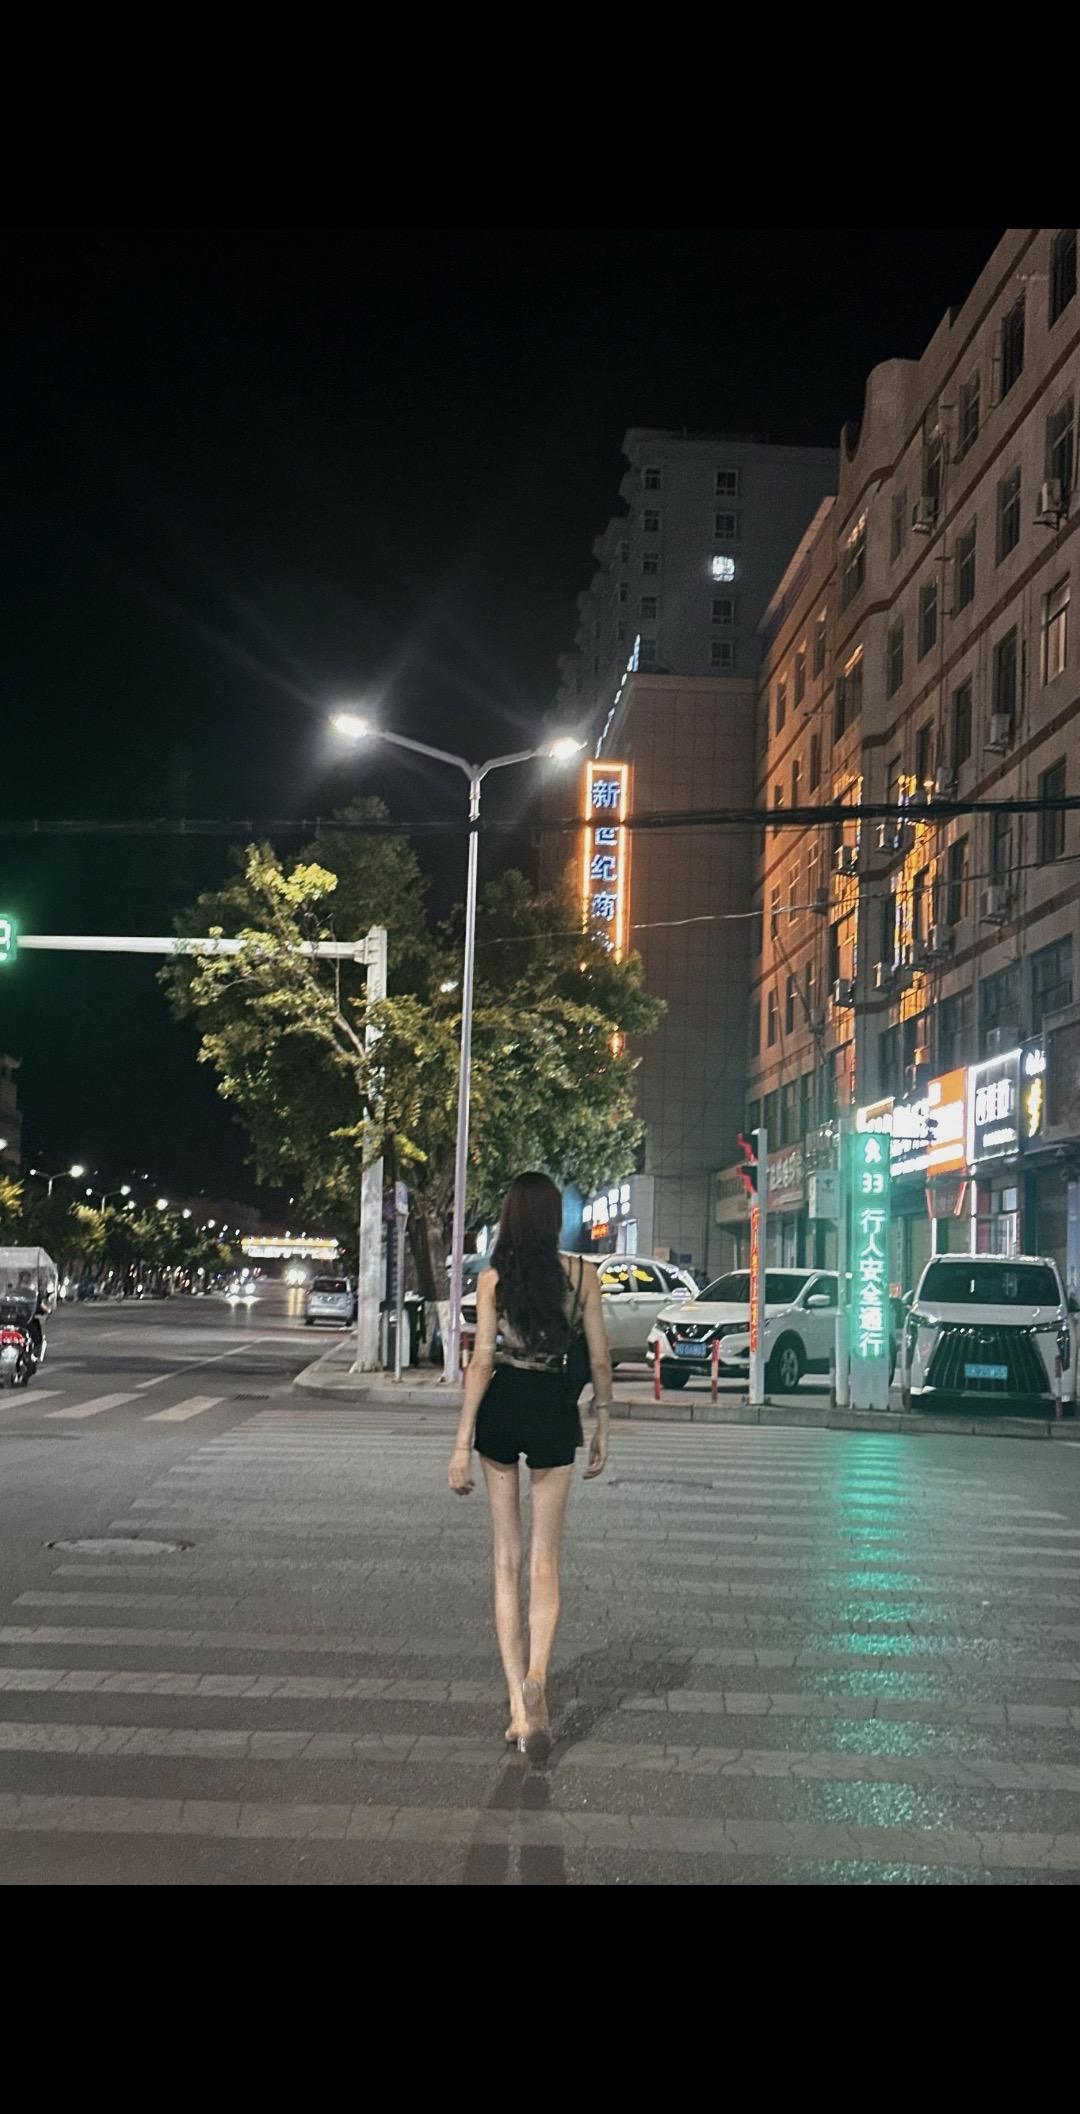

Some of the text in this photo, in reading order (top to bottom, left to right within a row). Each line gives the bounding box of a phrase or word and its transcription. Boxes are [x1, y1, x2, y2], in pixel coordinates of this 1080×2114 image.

[590, 779, 621, 953] 新世纪商
[862, 1173, 884, 1193] 33
[859, 1207, 886, 1357] 行人安全通行
